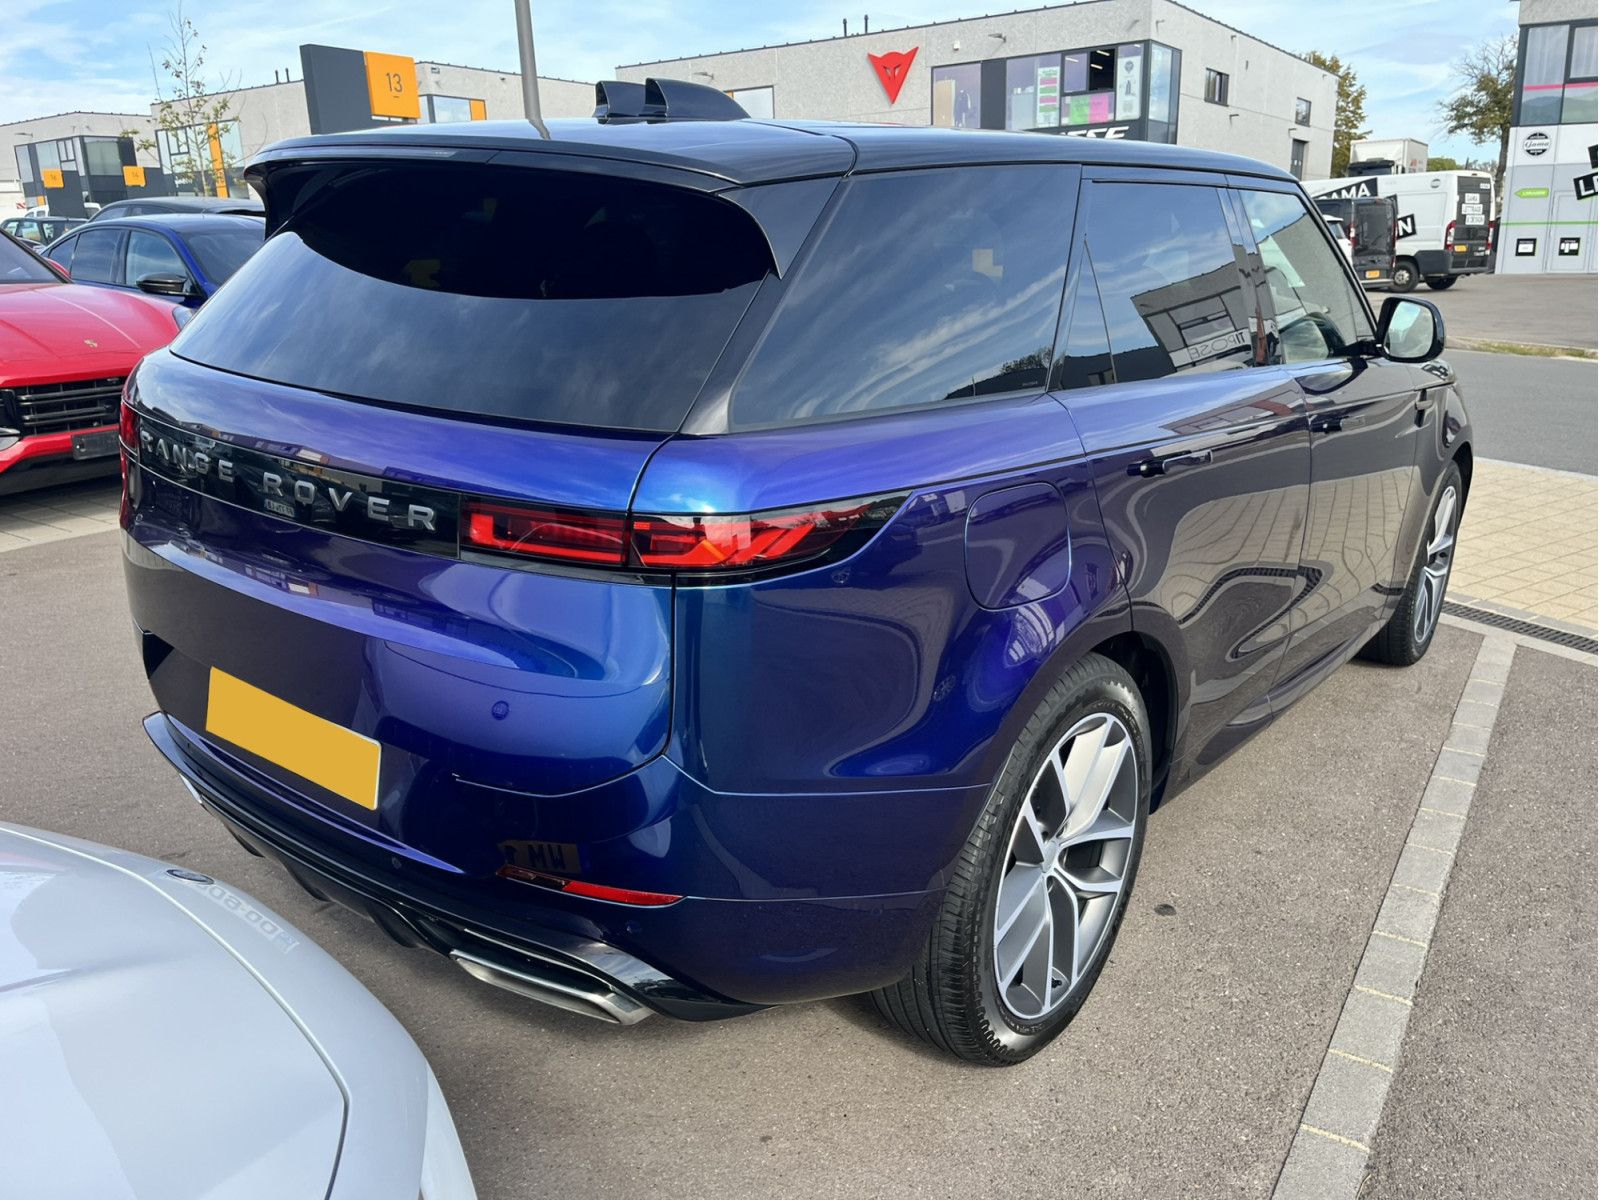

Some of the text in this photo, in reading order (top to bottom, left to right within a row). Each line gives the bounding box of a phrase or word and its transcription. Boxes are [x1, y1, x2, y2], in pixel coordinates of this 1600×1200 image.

[386, 72, 403, 93] 13
[1318, 182, 1371, 199] AMA
[140, 430, 436, 531] RANGE ROVER
